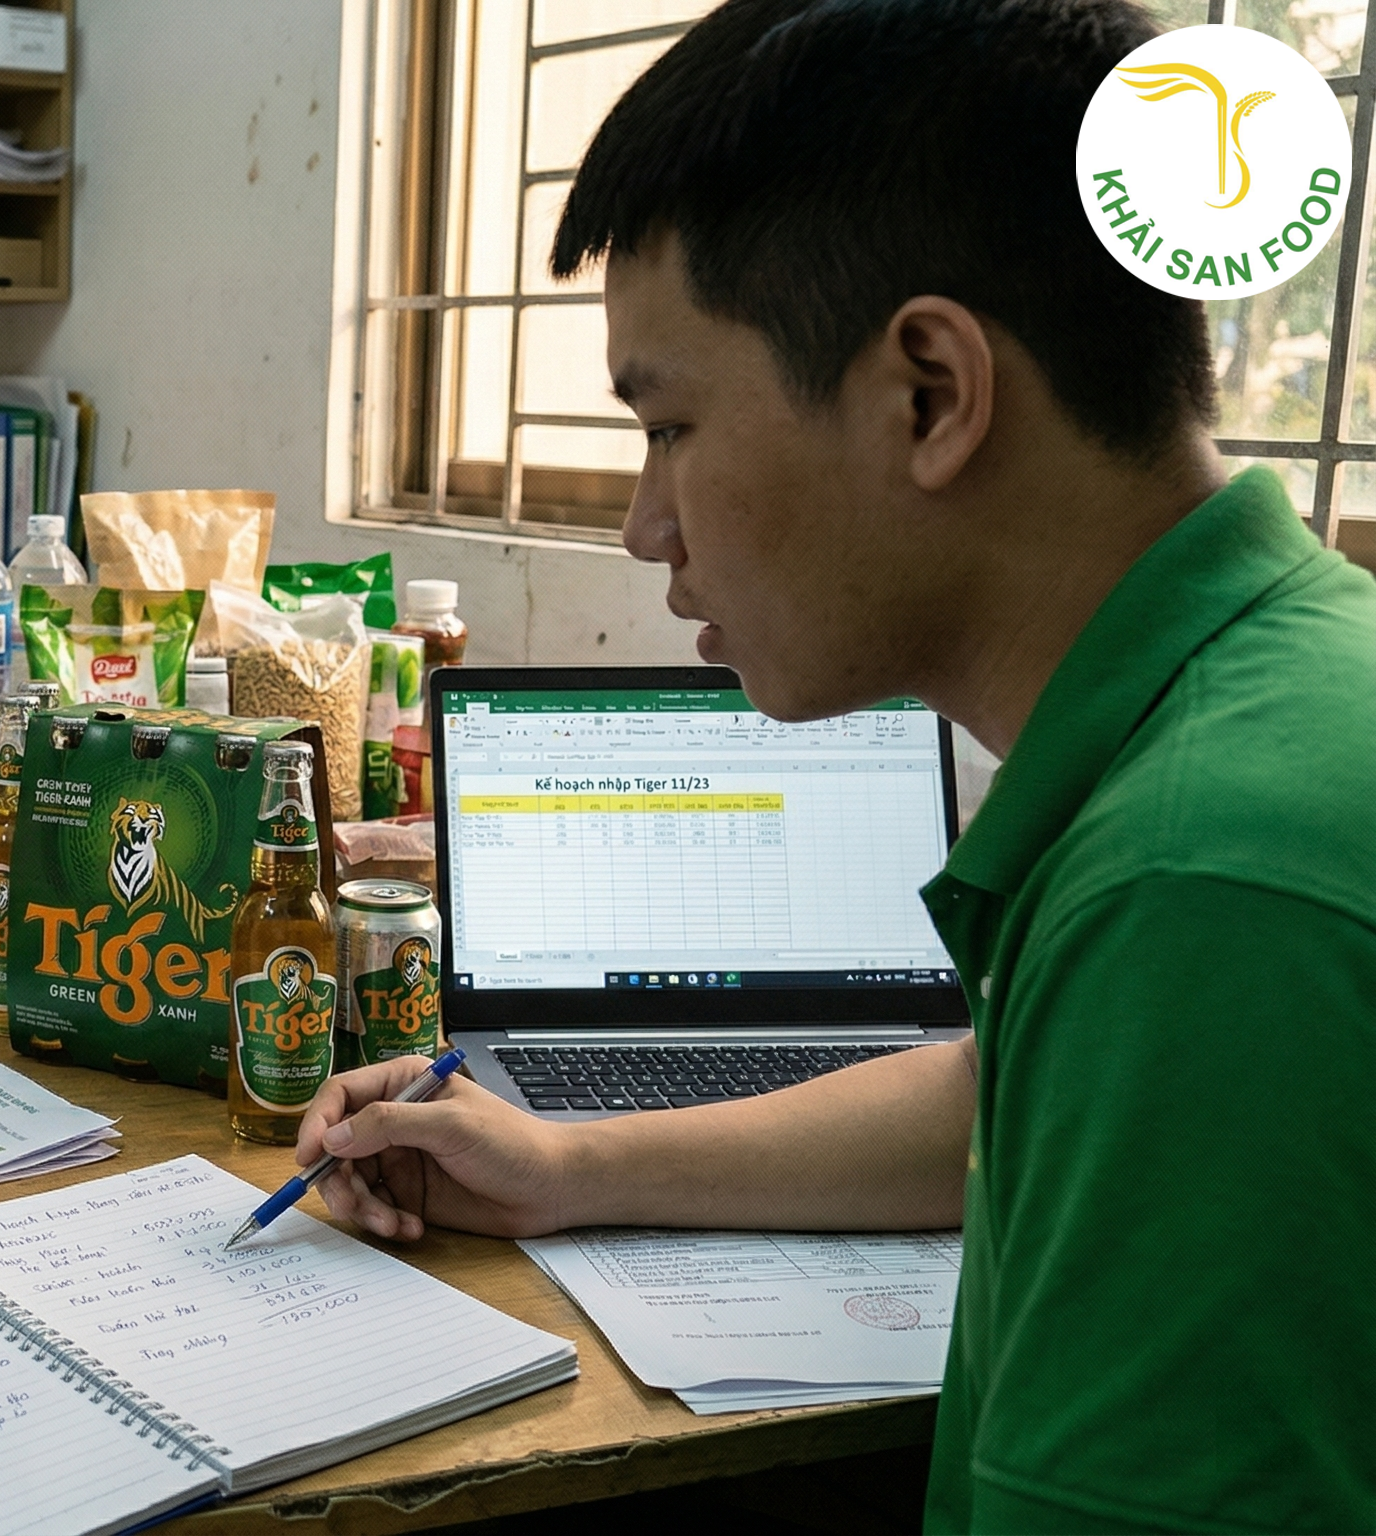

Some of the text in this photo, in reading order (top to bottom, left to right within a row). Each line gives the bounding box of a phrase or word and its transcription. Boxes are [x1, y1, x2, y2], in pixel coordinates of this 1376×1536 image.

[535, 776, 710, 793] Kế hoạch nhập Tiger 11/23
[25, 902, 231, 1025] Tiger
[49, 984, 96, 1004] GREEN
[362, 984, 440, 1034] Tiger
[157, 1003, 197, 1022] XANH
[241, 1000, 332, 1051] Tiger
